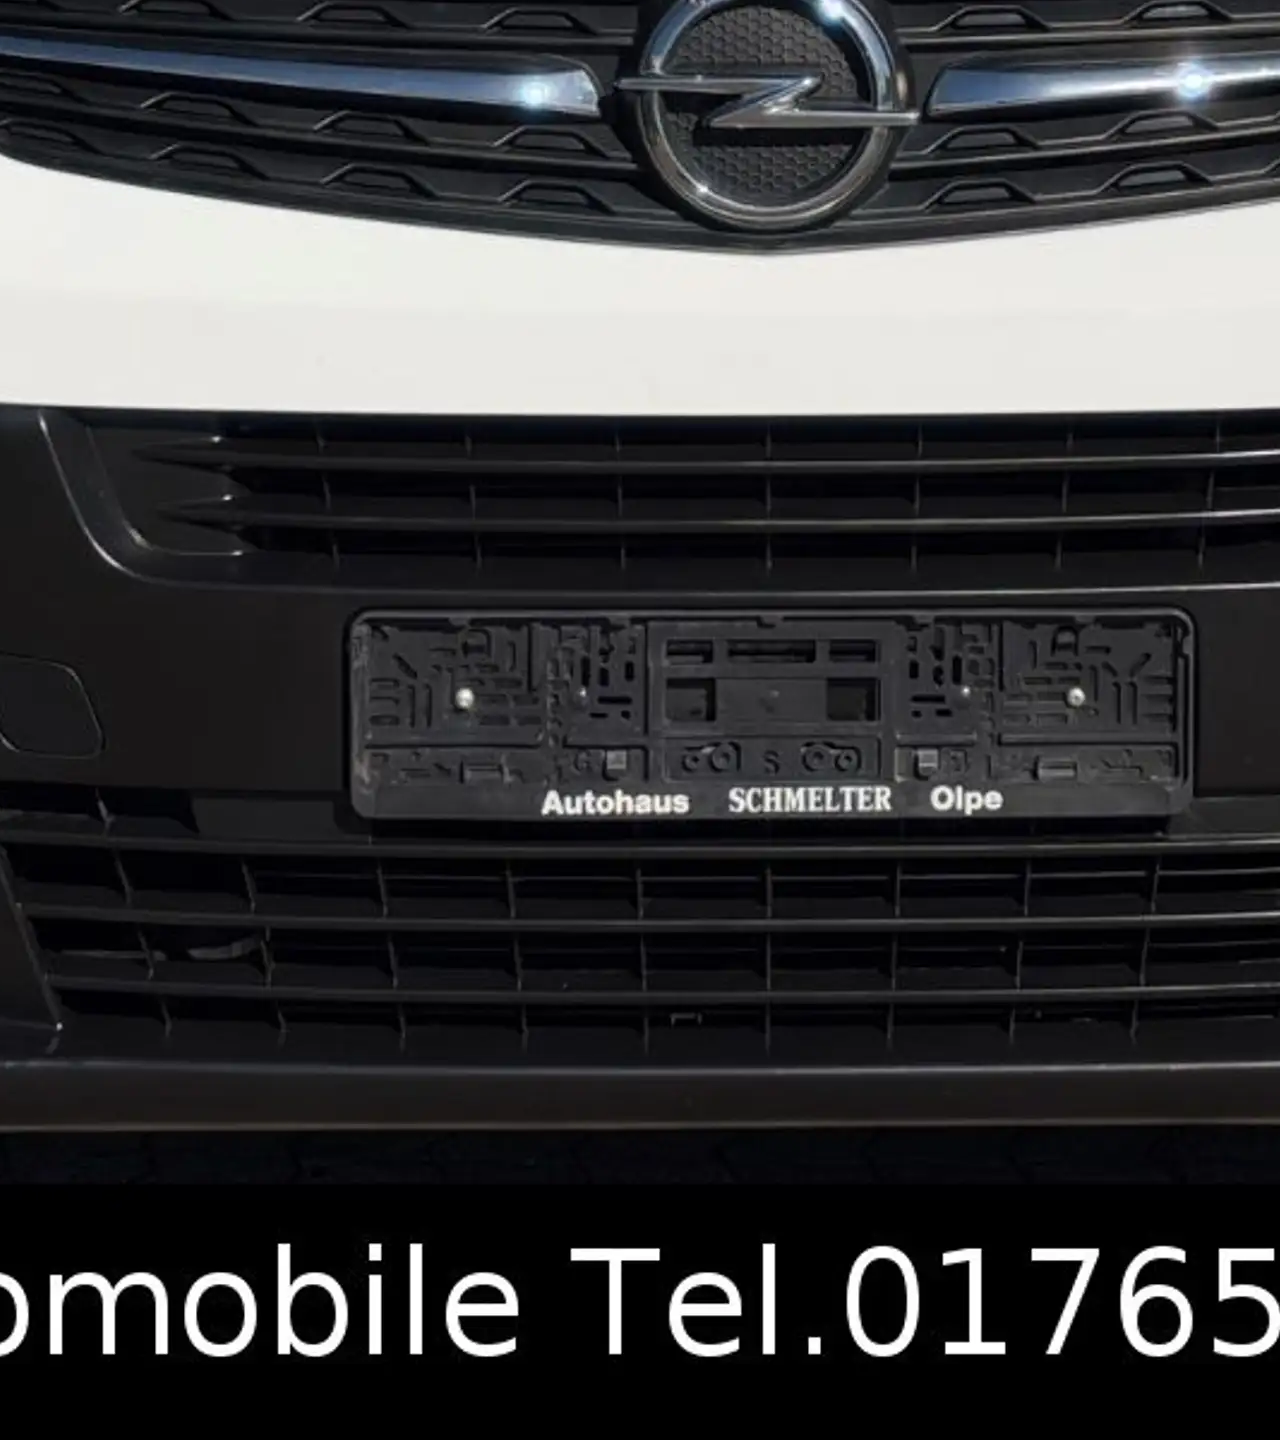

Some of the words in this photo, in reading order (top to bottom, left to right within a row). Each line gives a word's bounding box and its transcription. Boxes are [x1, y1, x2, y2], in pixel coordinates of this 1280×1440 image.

[540, 788, 690, 816] Autohaus
[728, 785, 893, 814] SCHMELTER
[929, 785, 1004, 817] Olpe
